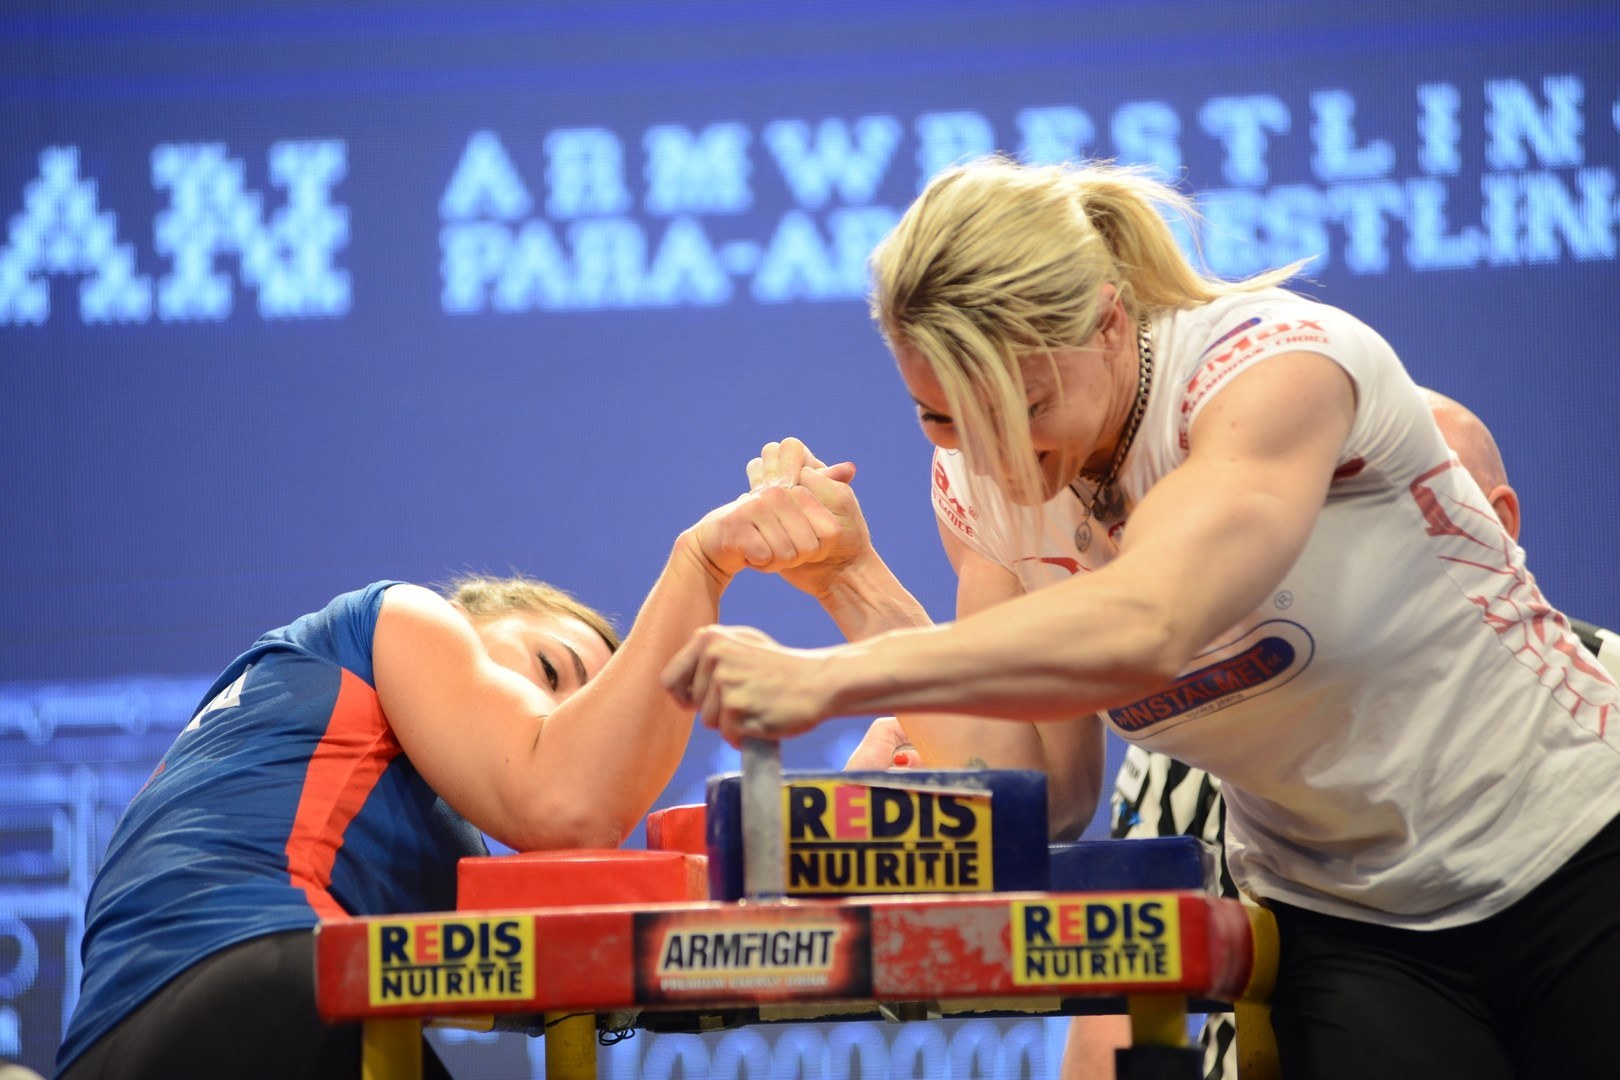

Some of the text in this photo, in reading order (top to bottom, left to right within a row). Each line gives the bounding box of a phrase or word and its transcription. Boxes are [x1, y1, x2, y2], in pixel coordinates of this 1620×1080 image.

[441, 75, 1620, 221] ARMWRESTLIN
[789, 782, 978, 840] REDIS
[789, 843, 980, 889] NUTRITIE
[381, 921, 522, 964] REDIS
[1024, 901, 1166, 943] REDIS
[664, 930, 835, 970] ARMFIGHT
[1024, 943, 1168, 979] NUTRITIE
[381, 962, 522, 998] NUTRITIE
